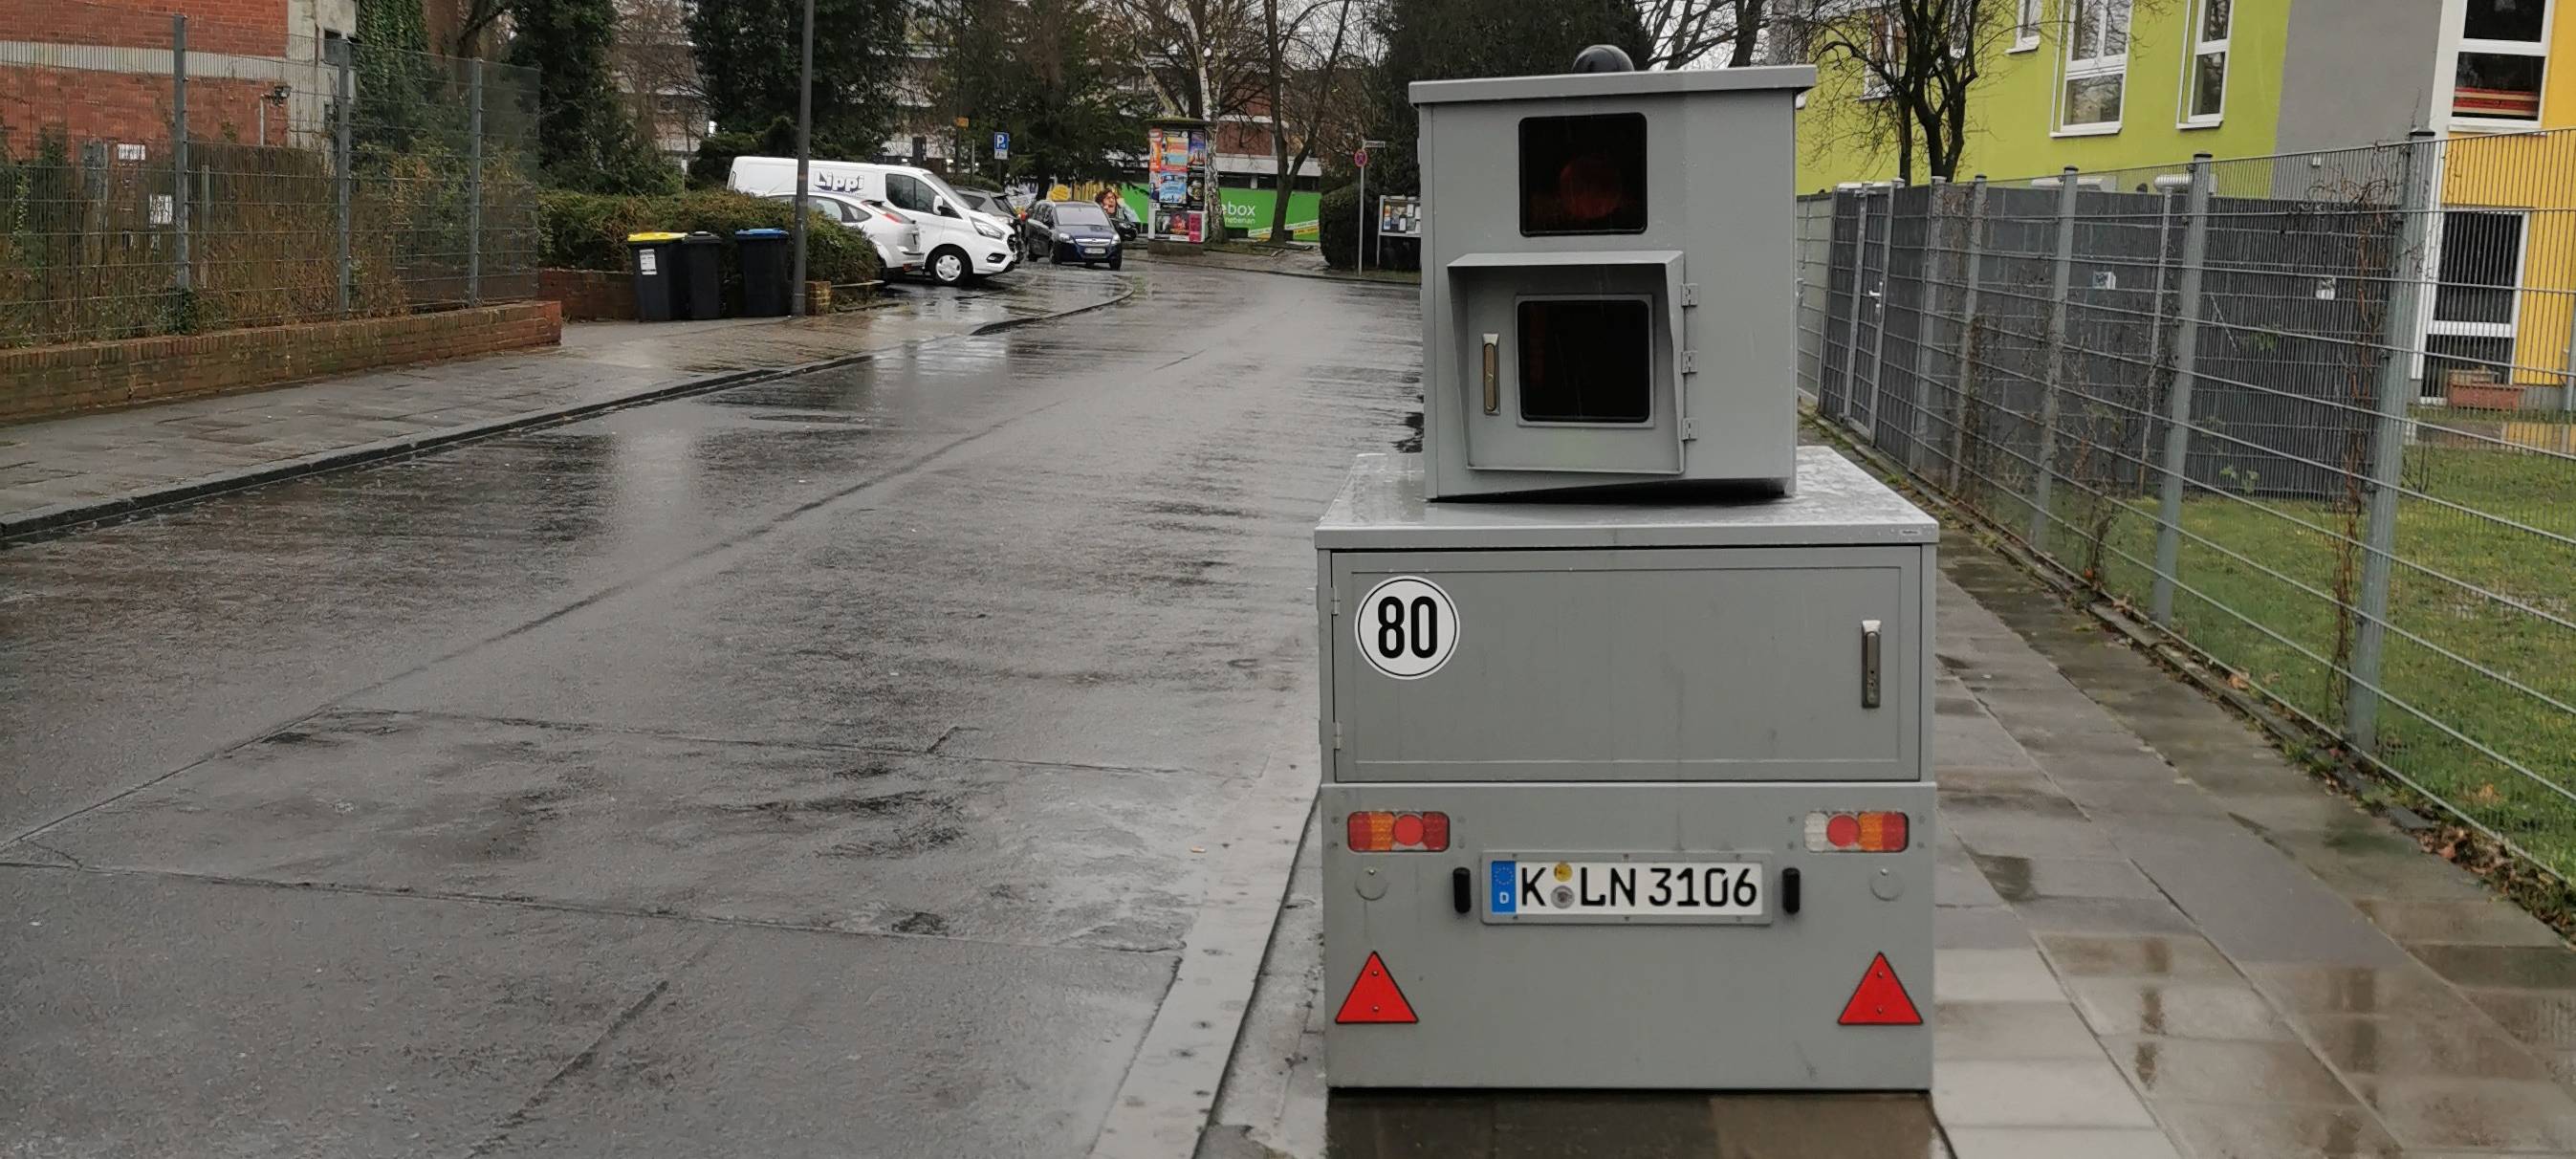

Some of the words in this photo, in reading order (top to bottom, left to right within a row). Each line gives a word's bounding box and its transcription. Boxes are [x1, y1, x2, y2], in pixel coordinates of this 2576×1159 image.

[996, 134, 1005, 148] P
[814, 169, 864, 191] Lippi
[1377, 596, 1438, 659] 80
[1520, 866, 1546, 907] K
[1581, 866, 1636, 907] LN
[1648, 867, 1757, 907] 3106
[1498, 892, 1509, 904] D
